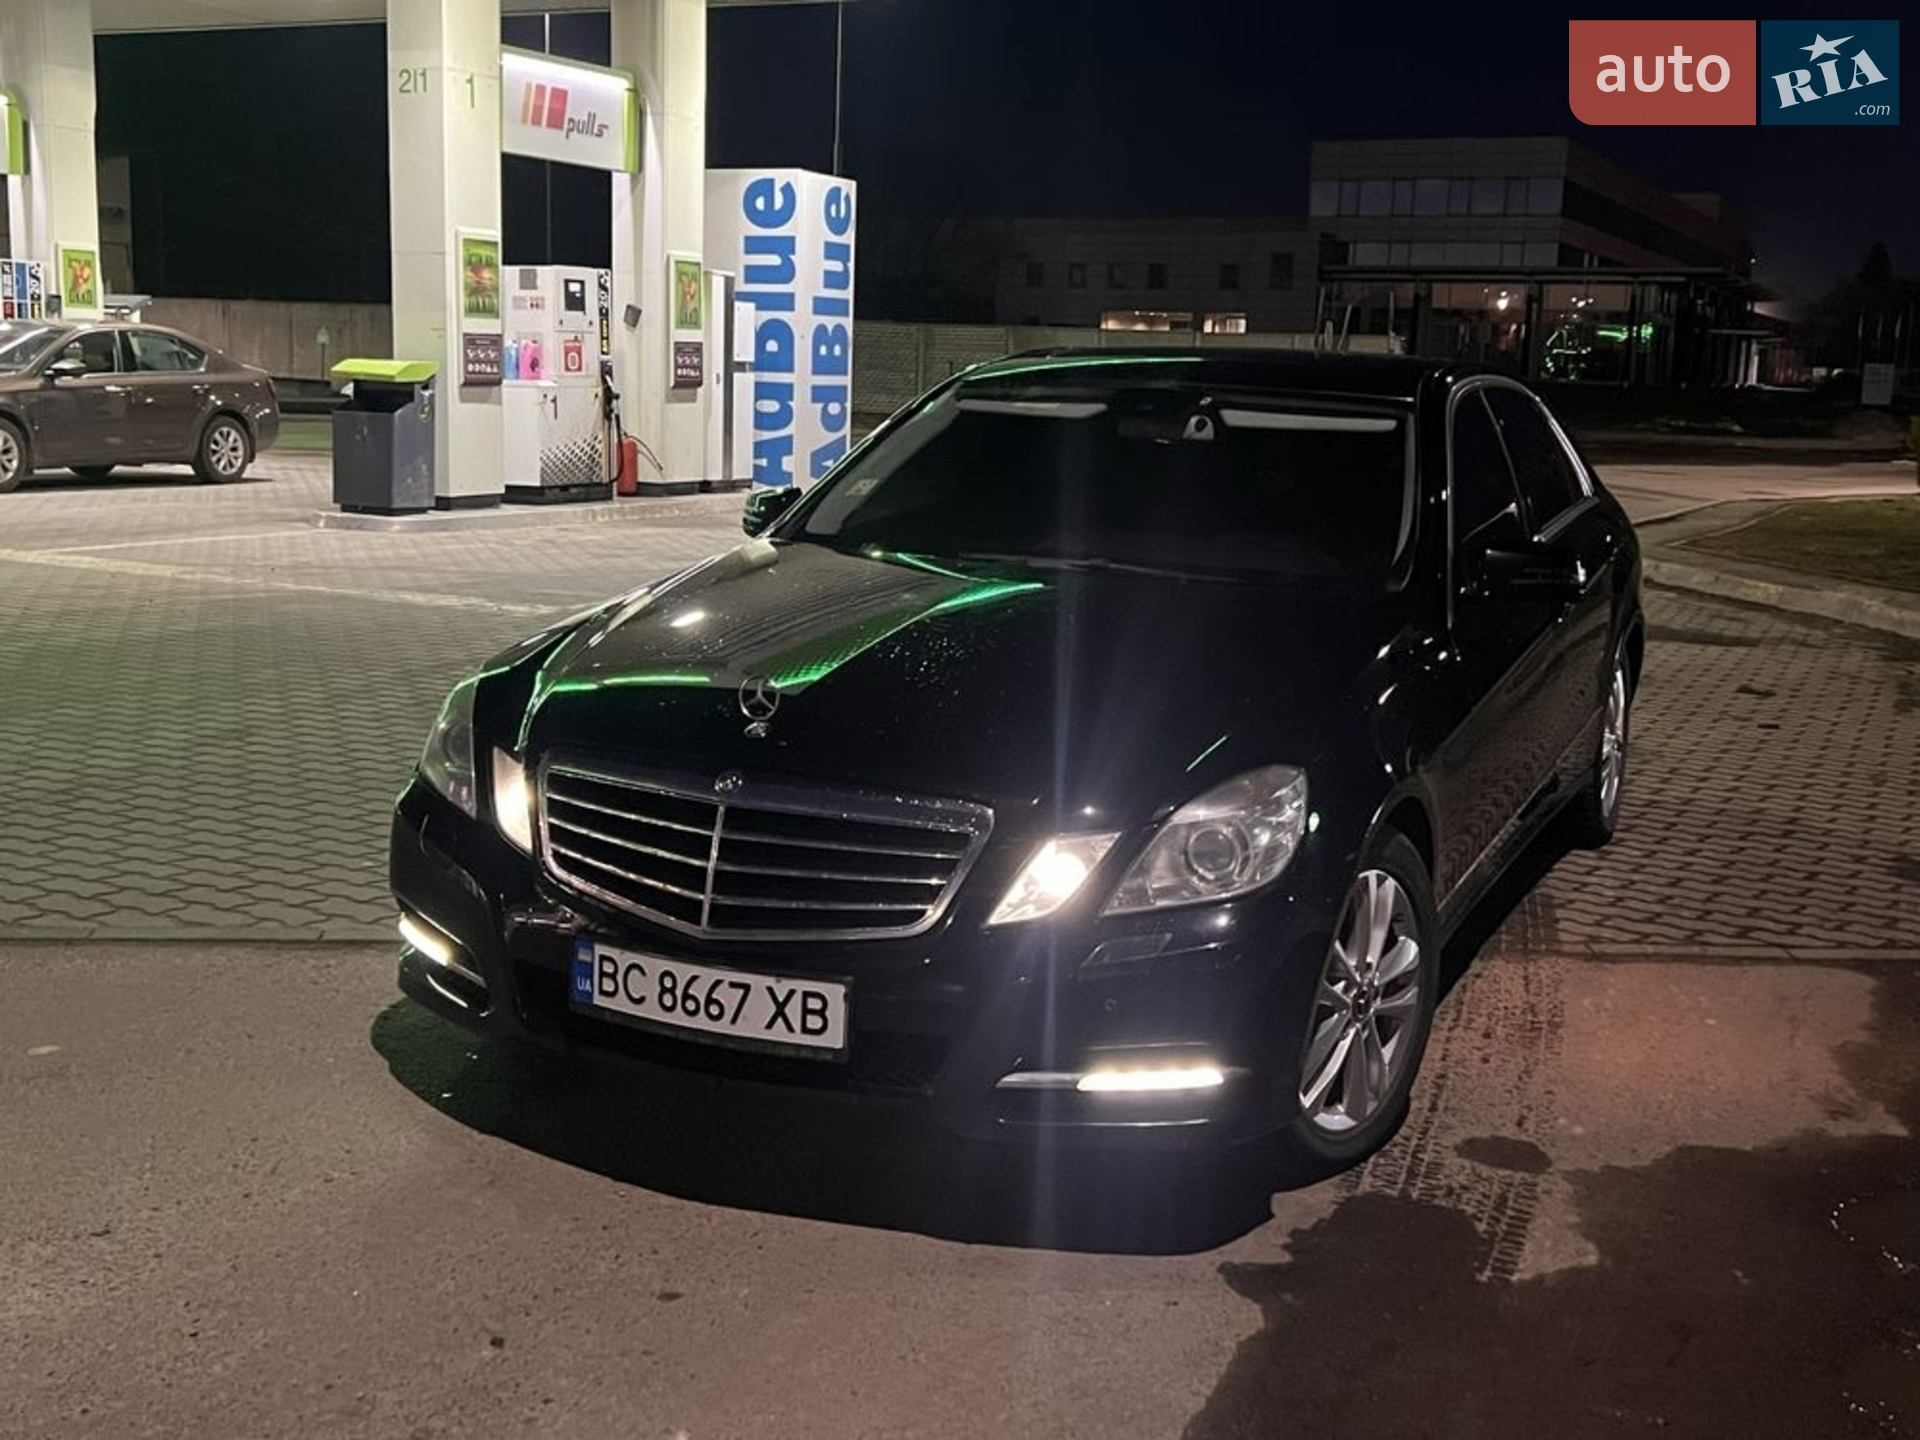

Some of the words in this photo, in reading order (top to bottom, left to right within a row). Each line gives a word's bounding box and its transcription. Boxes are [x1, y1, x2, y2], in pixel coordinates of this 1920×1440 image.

[465, 73, 475, 108] 1
[565, 112, 609, 139] pulls
[809, 185, 851, 480] AdBlue
[550, 394, 558, 420] 1
[577, 976, 592, 993] UA
[598, 954, 648, 1005] BC
[657, 969, 752, 1026] 8667
[764, 985, 829, 1036] XB
